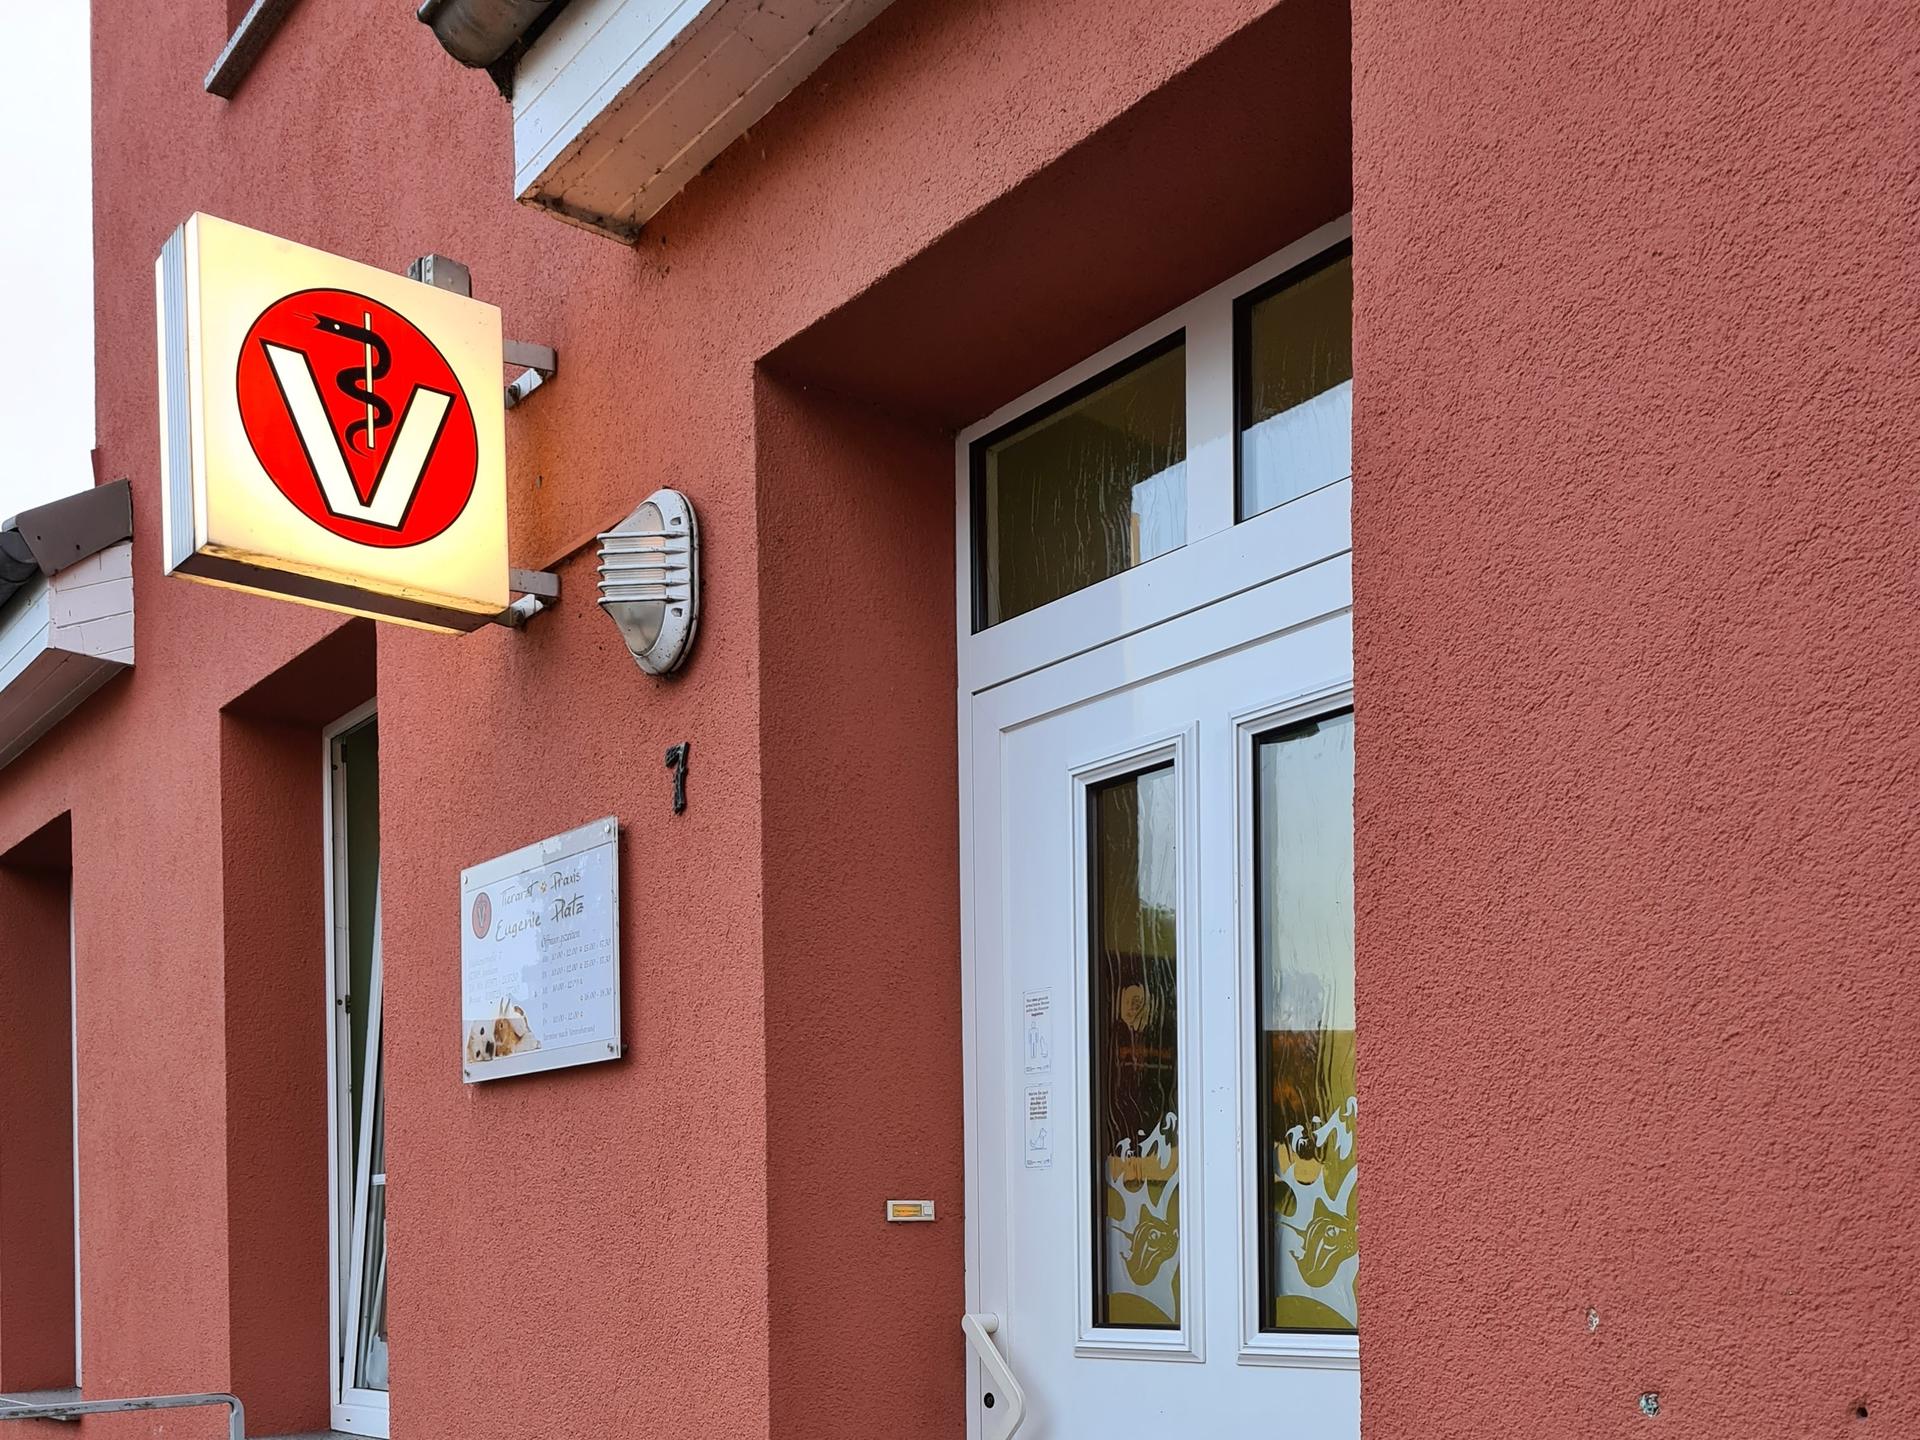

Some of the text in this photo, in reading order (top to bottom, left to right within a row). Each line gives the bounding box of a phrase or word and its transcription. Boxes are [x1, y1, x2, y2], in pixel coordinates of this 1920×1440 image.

[665, 742, 690, 815] 7
[550, 868, 581, 891] Praxis
[495, 893, 584, 942] Eugenie Platz
